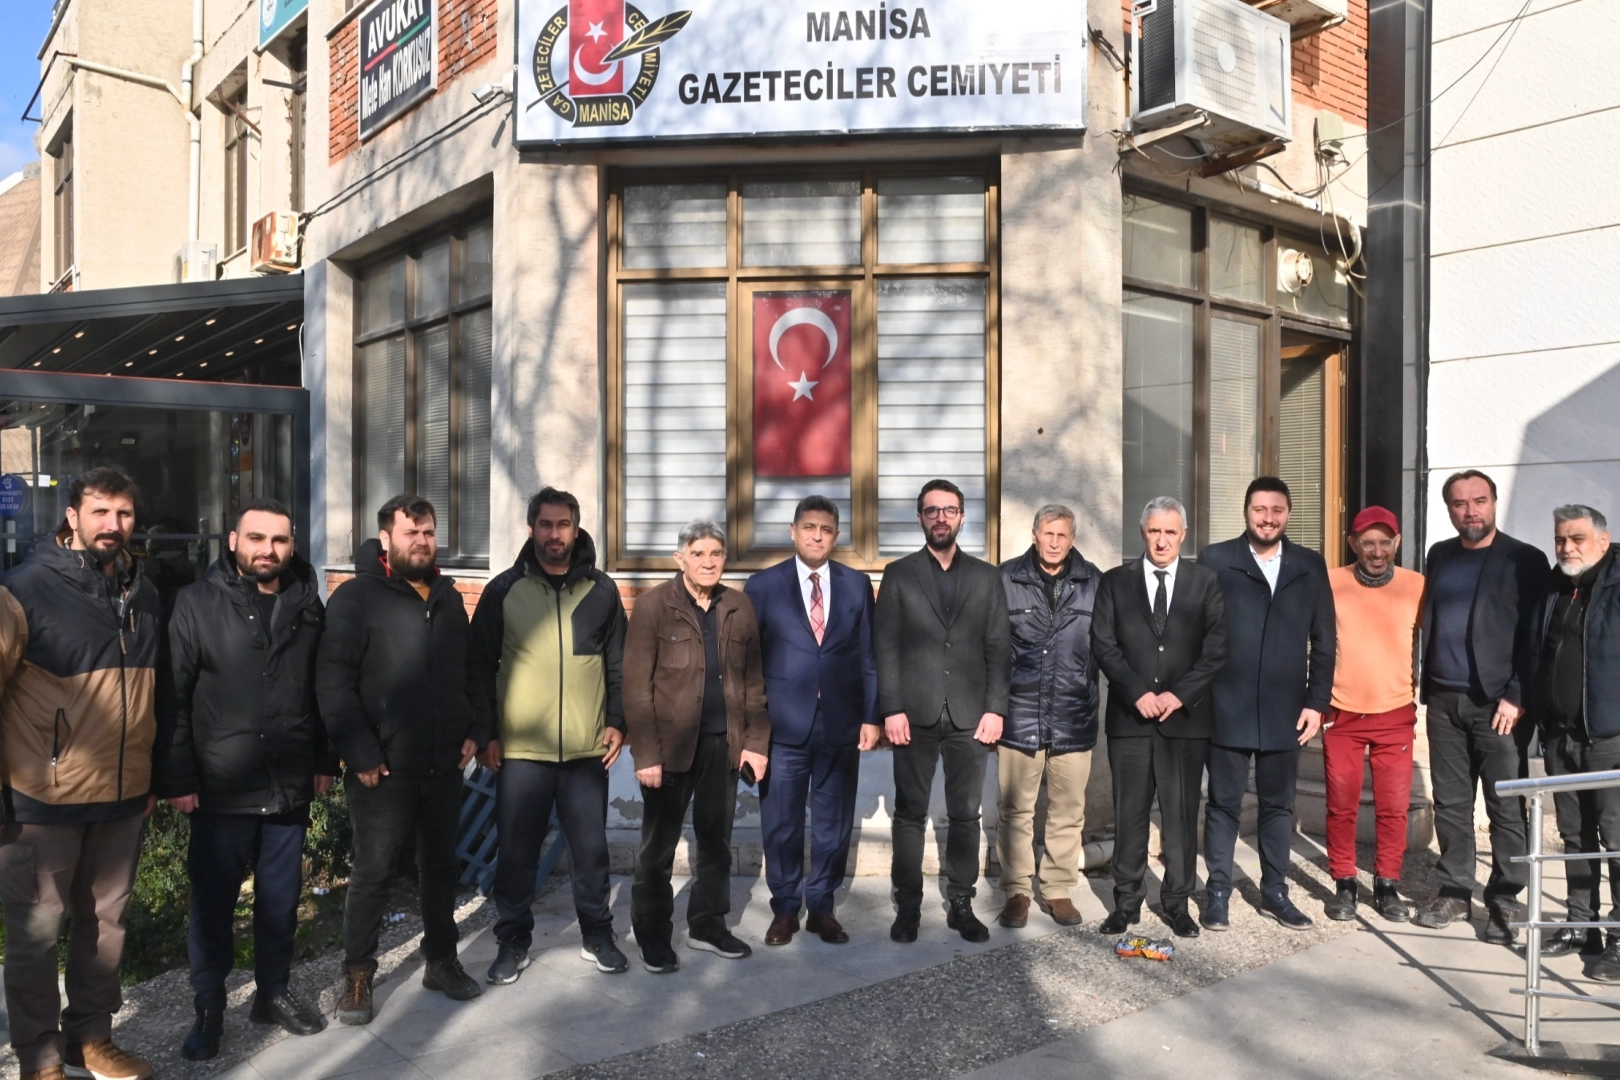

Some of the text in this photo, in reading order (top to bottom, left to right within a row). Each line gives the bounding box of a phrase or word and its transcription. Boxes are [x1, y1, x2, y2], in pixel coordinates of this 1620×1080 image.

[806, 1, 931, 42] MANİSA
[362, 26, 431, 120] Mete Han KORKUSUZ
[678, 54, 1062, 104] GAZETECİLER CEMİYETİ
[579, 99, 630, 122] MANİSA
